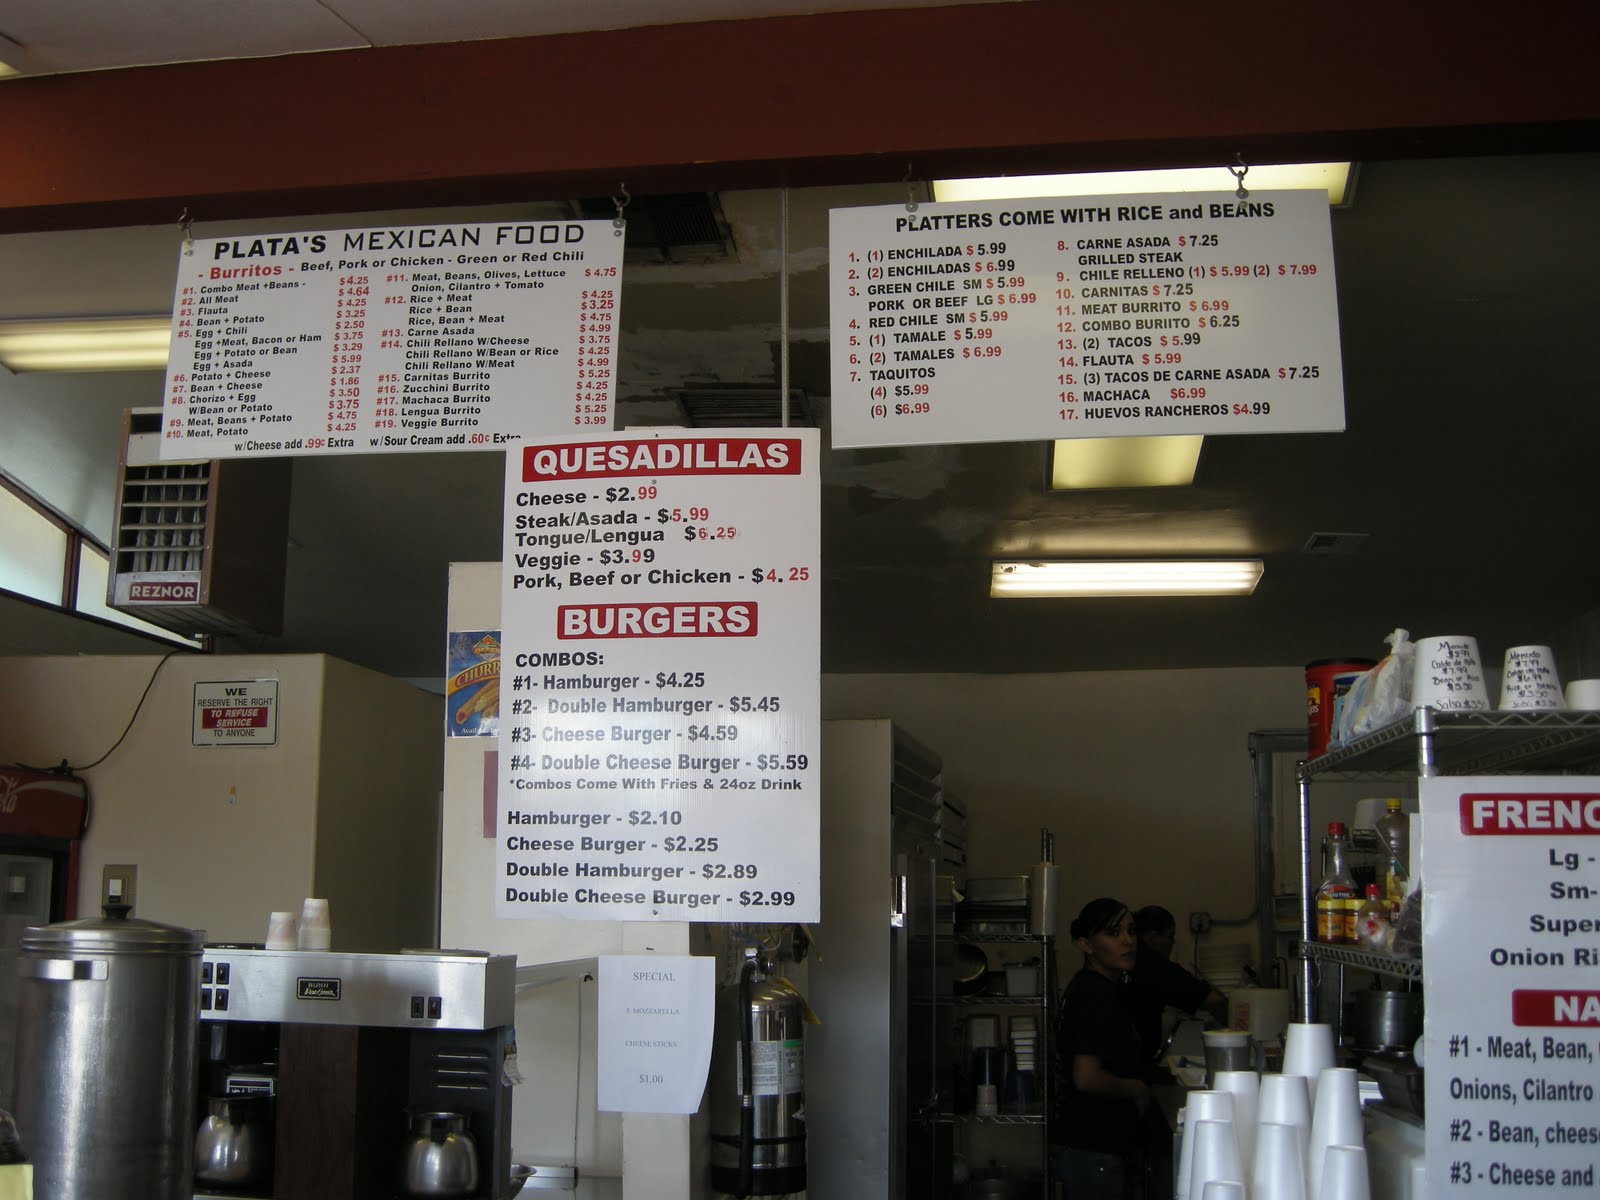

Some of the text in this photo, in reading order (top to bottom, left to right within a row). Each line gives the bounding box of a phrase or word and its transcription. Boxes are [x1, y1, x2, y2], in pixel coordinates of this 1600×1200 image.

[896, 203, 1275, 233] PLATTERS COME WITH RICE and BEANS
[214, 224, 584, 261] PLATA'S MEXICAN FOOD
[888, 246, 962, 260] ENCHILADA
[1078, 252, 1183, 266] GRILLED STEAK
[210, 251, 584, 280] Burritos Beef, Pork or Chicken Green or Red Chili
[412, 270, 566, 282] Meat, Beans, Olives, Lettuce
[1079, 267, 1185, 282] CHILE RELLENO
[200, 286, 233, 294] Combo
[236, 283, 259, 291] Meat
[868, 280, 955, 295] GREEN CHILE
[1081, 285, 1148, 299] CARNITAS
[198, 307, 228, 315] Flauta
[869, 296, 968, 312] PORK OR BEEF
[1082, 301, 1181, 316] MEAT BURRITO
[1082, 320, 1131, 332] COMBO
[1083, 355, 1134, 366] FLAUTA
[870, 367, 936, 381] TAQUITOS
[895, 384, 929, 396] $5.99
[1083, 387, 1206, 402] MACHACA $6.99
[895, 402, 930, 415] $6.99
[1085, 402, 1271, 420] HUEVOS RANCHEROS $4.99
[401, 418, 479, 428] Veggie Burrito
[234, 441, 281, 451] w/Cheese
[285, 439, 302, 449] add
[327, 437, 354, 448] Extra
[533, 443, 789, 476] QUESADILLAS
[516, 486, 657, 507] Cheese $2.99
[516, 510, 637, 529] Steak/Asada
[516, 529, 664, 547] Tongue/Lengua
[515, 549, 655, 570] Veggie $3.99
[513, 574, 562, 590] Pork,
[570, 570, 614, 587] Beef
[621, 571, 641, 585] or
[648, 569, 731, 584] Chicken
[132, 585, 194, 598] REZNOR
[564, 605, 750, 636] BURGERS
[515, 651, 604, 668] COMBOS:
[543, 672, 639, 692] Hamburger
[656, 672, 705, 689] $4.25
[225, 708, 258, 717] REFUSE
[548, 697, 607, 714] Double
[612, 697, 713, 716] Hamburger
[729, 696, 780, 713] $5.45
[1436, 699, 1461, 710] Salsa
[217, 719, 252, 727] SERVICE
[226, 729, 255, 737] ANYONE
[542, 725, 605, 741] Cheese
[611, 726, 671, 744] Burger
[688, 724, 738, 742] $4.59
[542, 754, 600, 770] Double
[606, 754, 671, 770] Cheese
[678, 754, 740, 773] Burger
[757, 754, 808, 771] $5.59
[576, 779, 617, 790] Come
[622, 778, 656, 789] With
[660, 779, 697, 790] Fries
[703, 779, 714, 790] &
[719, 779, 756, 790] 24oz
[761, 779, 802, 790] Drink
[508, 810, 682, 829] Hamburger $2.10
[506, 836, 718, 854] Cheese Burger $2.25
[1550, 849, 1579, 871] Lg
[506, 863, 758, 881] Double Hamburger $2.89
[506, 888, 795, 908] Double Cheese Burger $2.99
[1490, 948, 1564, 966] Onion
[633, 972, 676, 981] SPECIAL
[1554, 996, 1600, 1022] NA
[1488, 1036, 1536, 1063] Meat,
[1543, 1036, 1592, 1063] Bean,
[639, 1075, 663, 1084] $1.00
[1451, 1077, 1593, 1105] Onions, Cilantro
[1489, 1120, 1539, 1148] Bean,
[1545, 1121, 1600, 1144] chees
[1489, 1162, 1555, 1185] Cheese
[1562, 1164, 1593, 1186] and
